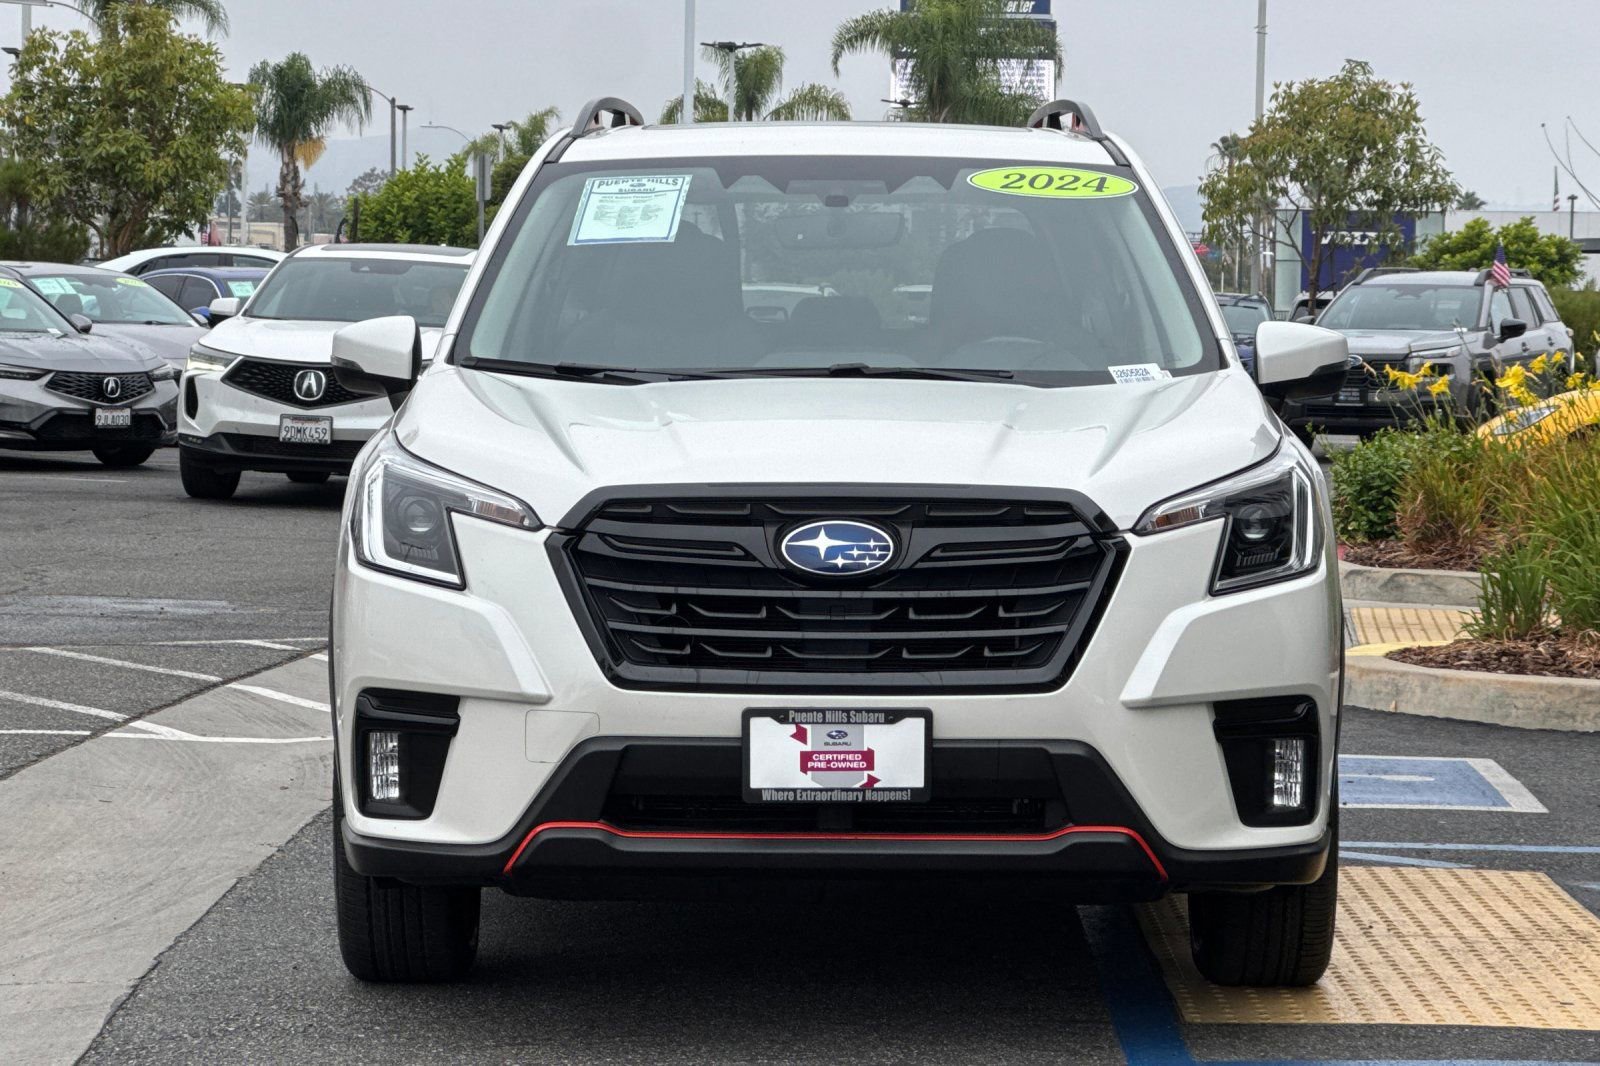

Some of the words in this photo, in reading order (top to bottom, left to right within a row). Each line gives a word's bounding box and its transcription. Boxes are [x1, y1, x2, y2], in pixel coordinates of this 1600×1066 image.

[597, 178, 642, 189] PUENTE
[647, 178, 679, 187] HILLS
[1000, 173, 1109, 192] 2024
[283, 425, 328, 439] 9DMK459
[789, 710, 823, 723] Puente
[826, 710, 848, 723] Hills
[850, 710, 885, 723] Subaru
[812, 753, 862, 761] CERTIFIED
[807, 761, 867, 769] PRE-OWNED
[762, 789, 794, 801] Where
[796, 789, 863, 802] Extraordinary
[865, 789, 911, 802] Happens!
